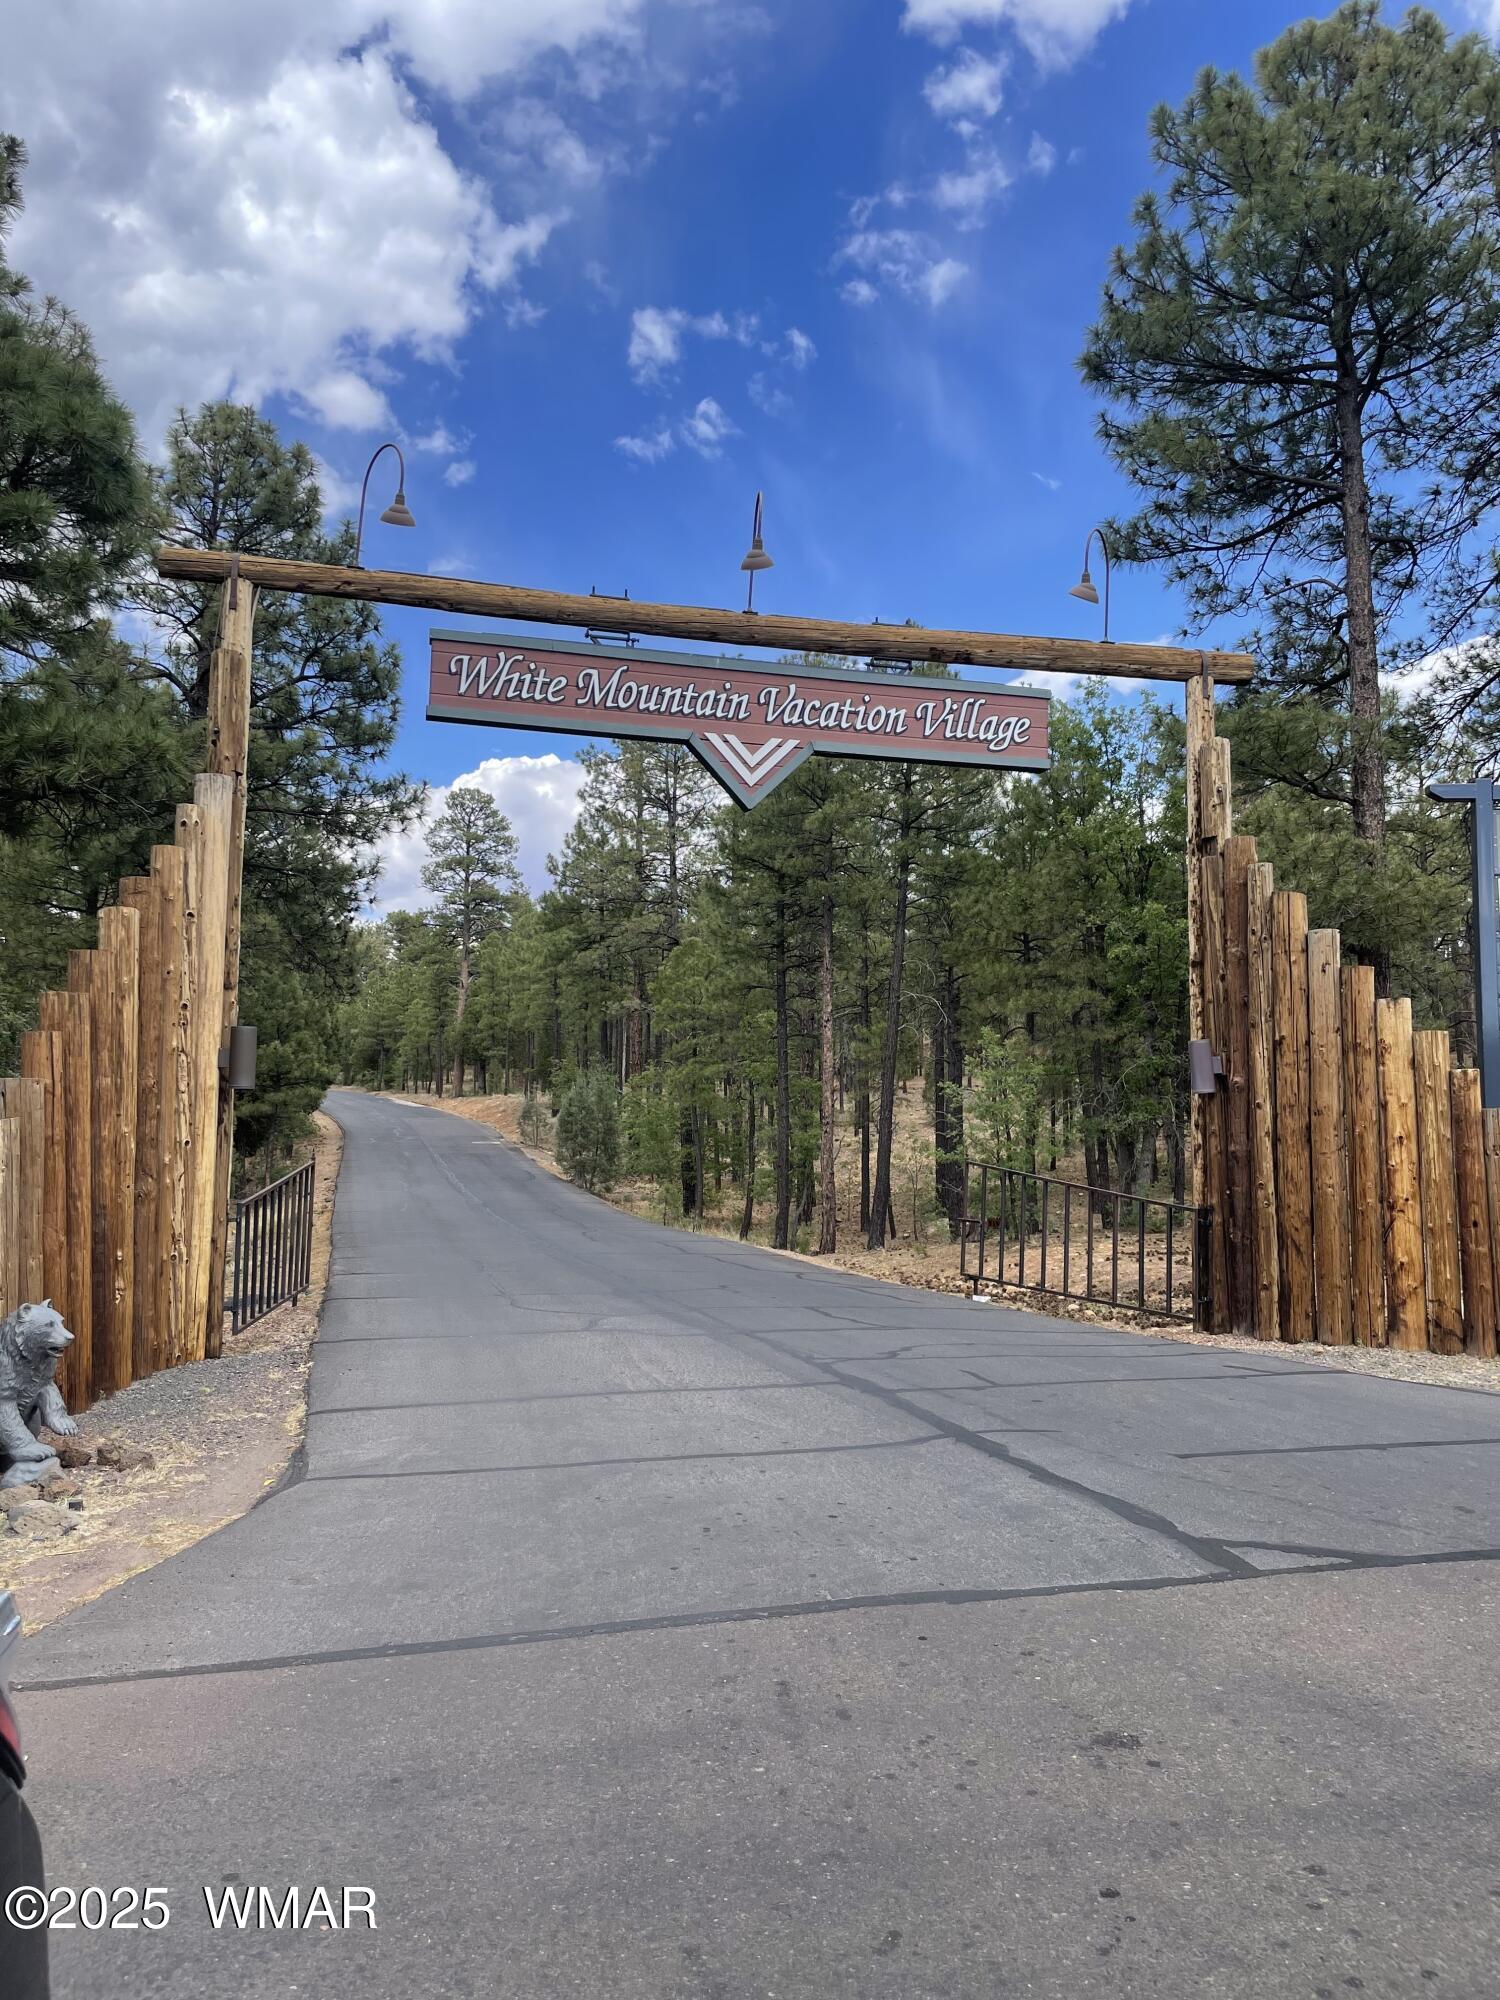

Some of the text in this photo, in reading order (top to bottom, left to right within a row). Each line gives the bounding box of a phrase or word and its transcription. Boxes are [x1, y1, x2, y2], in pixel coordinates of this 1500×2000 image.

[450, 651, 1030, 751] White Mountain Vacation Village
